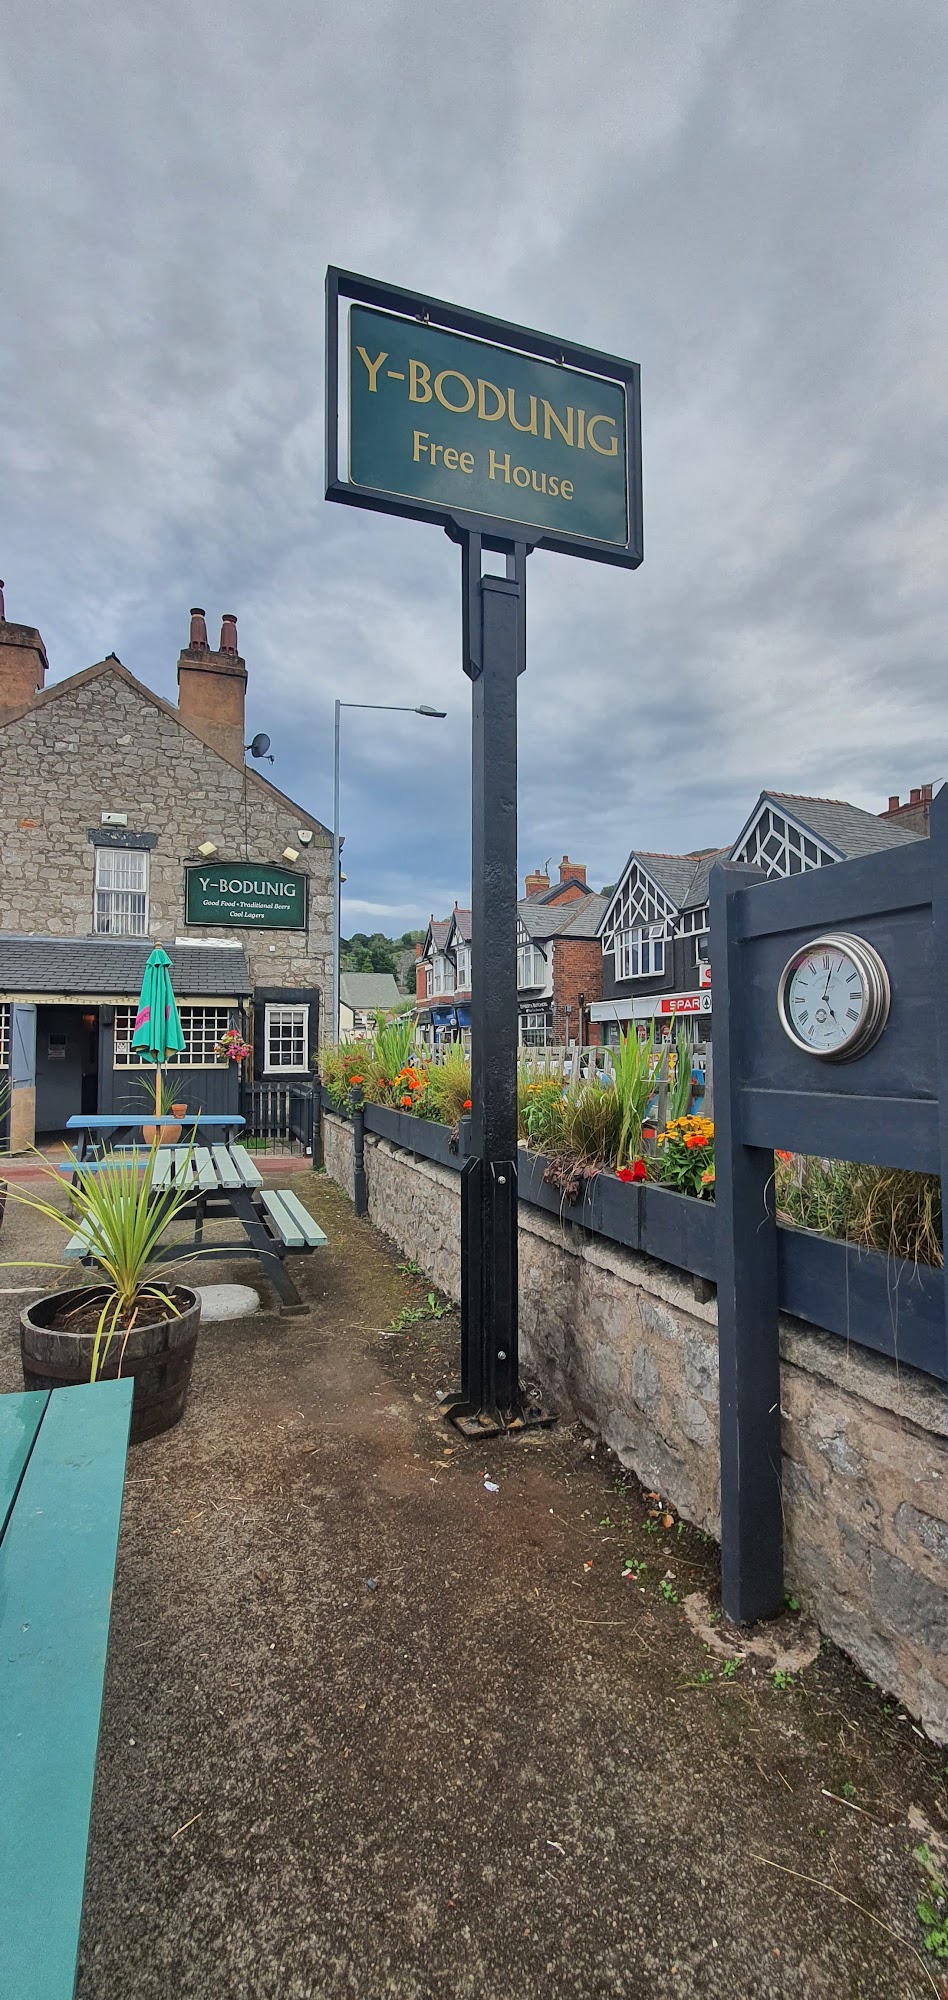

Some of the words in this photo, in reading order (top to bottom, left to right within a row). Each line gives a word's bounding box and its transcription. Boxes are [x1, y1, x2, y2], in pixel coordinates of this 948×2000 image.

[356, 345, 619, 456] Y-BODUNIG
[412, 430, 475, 474] Free
[488, 449, 575, 501] House
[199, 877, 296, 897] Y-BODUNIG
[240, 901, 274, 909] Traditional
[244, 912, 265, 920] Lagers
[669, 998, 700, 1011] SPAR
